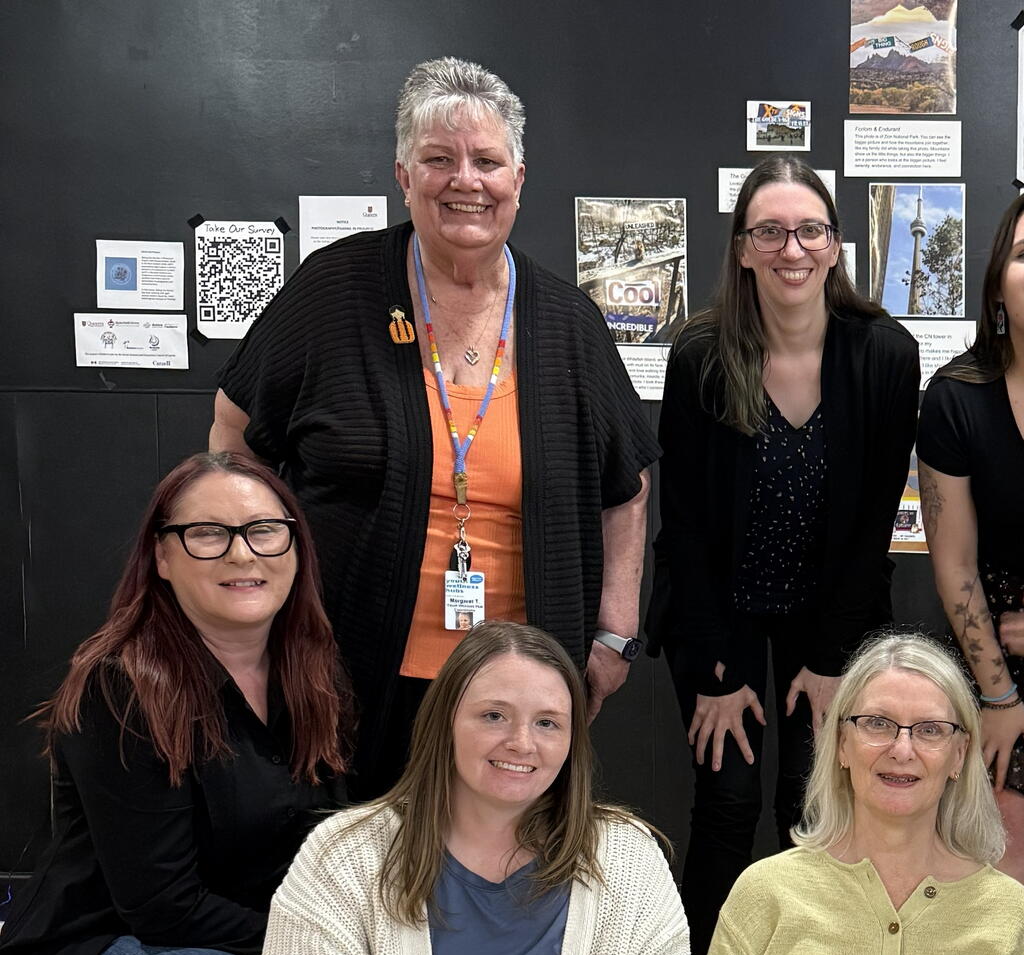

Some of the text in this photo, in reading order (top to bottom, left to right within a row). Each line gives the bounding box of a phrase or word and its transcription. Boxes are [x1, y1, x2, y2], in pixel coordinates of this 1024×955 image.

[204, 223, 276, 235] Take Our Survey
[625, 222, 655, 230] UNLEASHED
[608, 281, 660, 304] Cool
